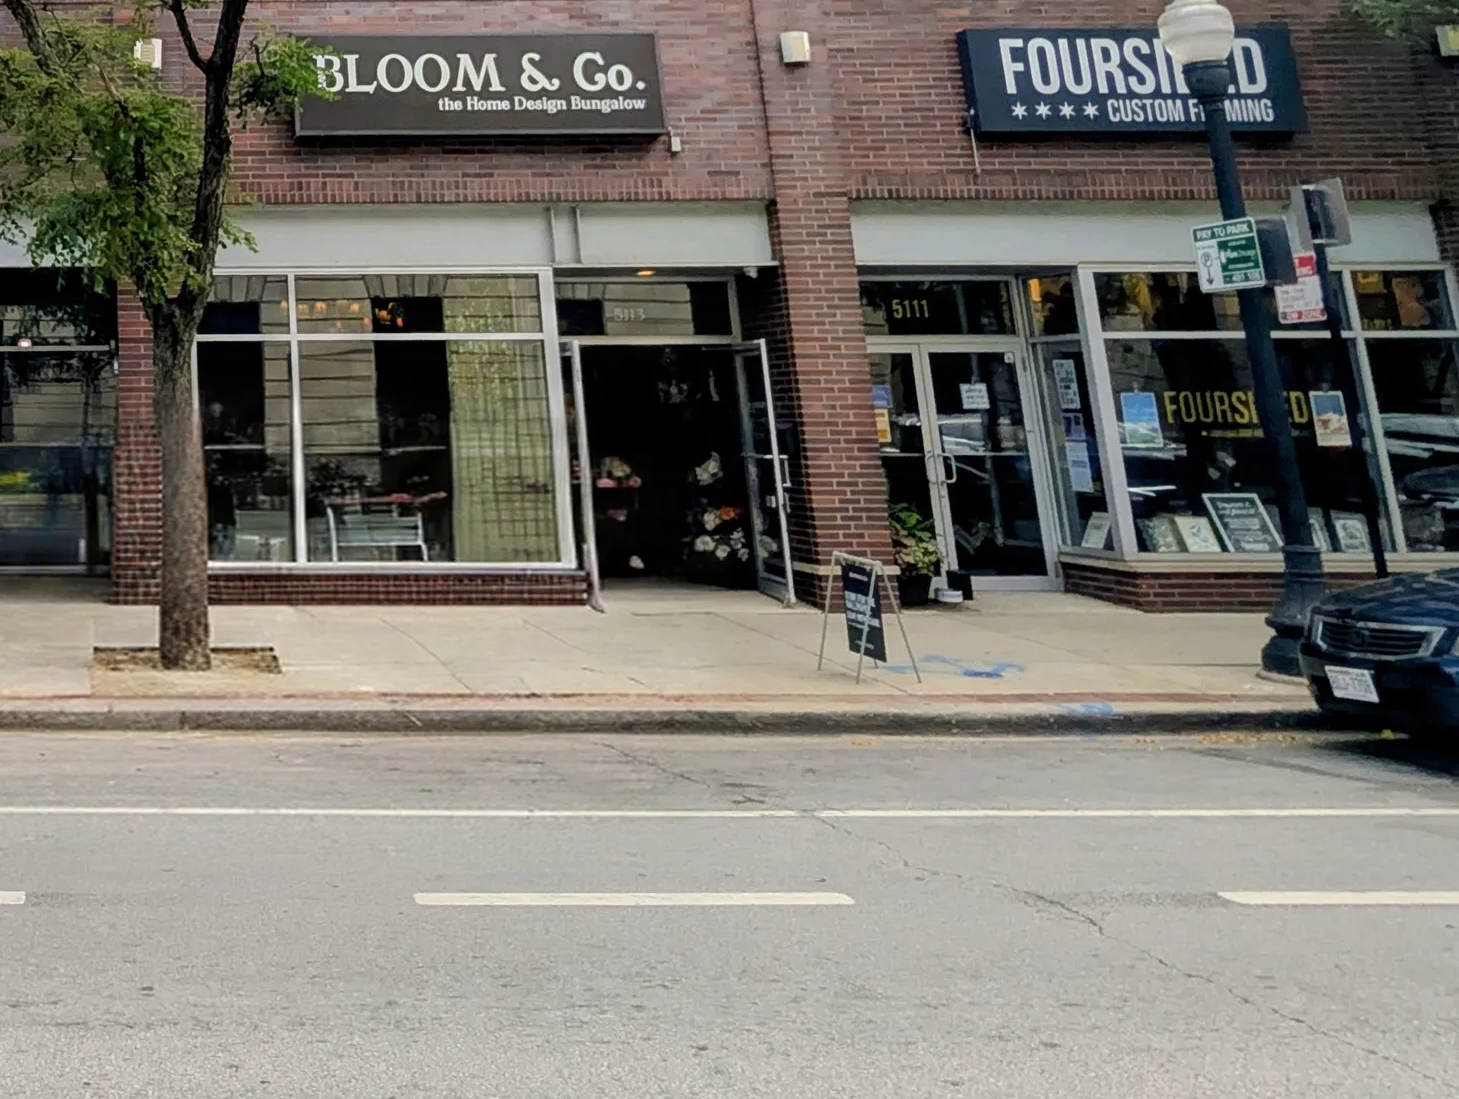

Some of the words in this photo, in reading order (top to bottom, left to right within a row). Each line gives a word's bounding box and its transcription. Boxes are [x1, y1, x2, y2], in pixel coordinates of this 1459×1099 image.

[312, 52, 506, 94] BLOOM
[520, 52, 560, 92] &
[572, 51, 646, 92] Co.
[998, 37, 1268, 94] FOURSID
[438, 97, 464, 111] the
[466, 96, 511, 111] Home
[513, 96, 567, 114] Design
[570, 95, 646, 114] Bungalow
[1107, 99, 1185, 122] CUSTOM
[1188, 98, 1275, 122] FMING
[1196, 229, 1212, 240] PAY
[1213, 227, 1226, 237] TO
[1226, 222, 1250, 235] PARK
[892, 299, 930, 318] 5111
[1163, 390, 1309, 424] FOURSID
